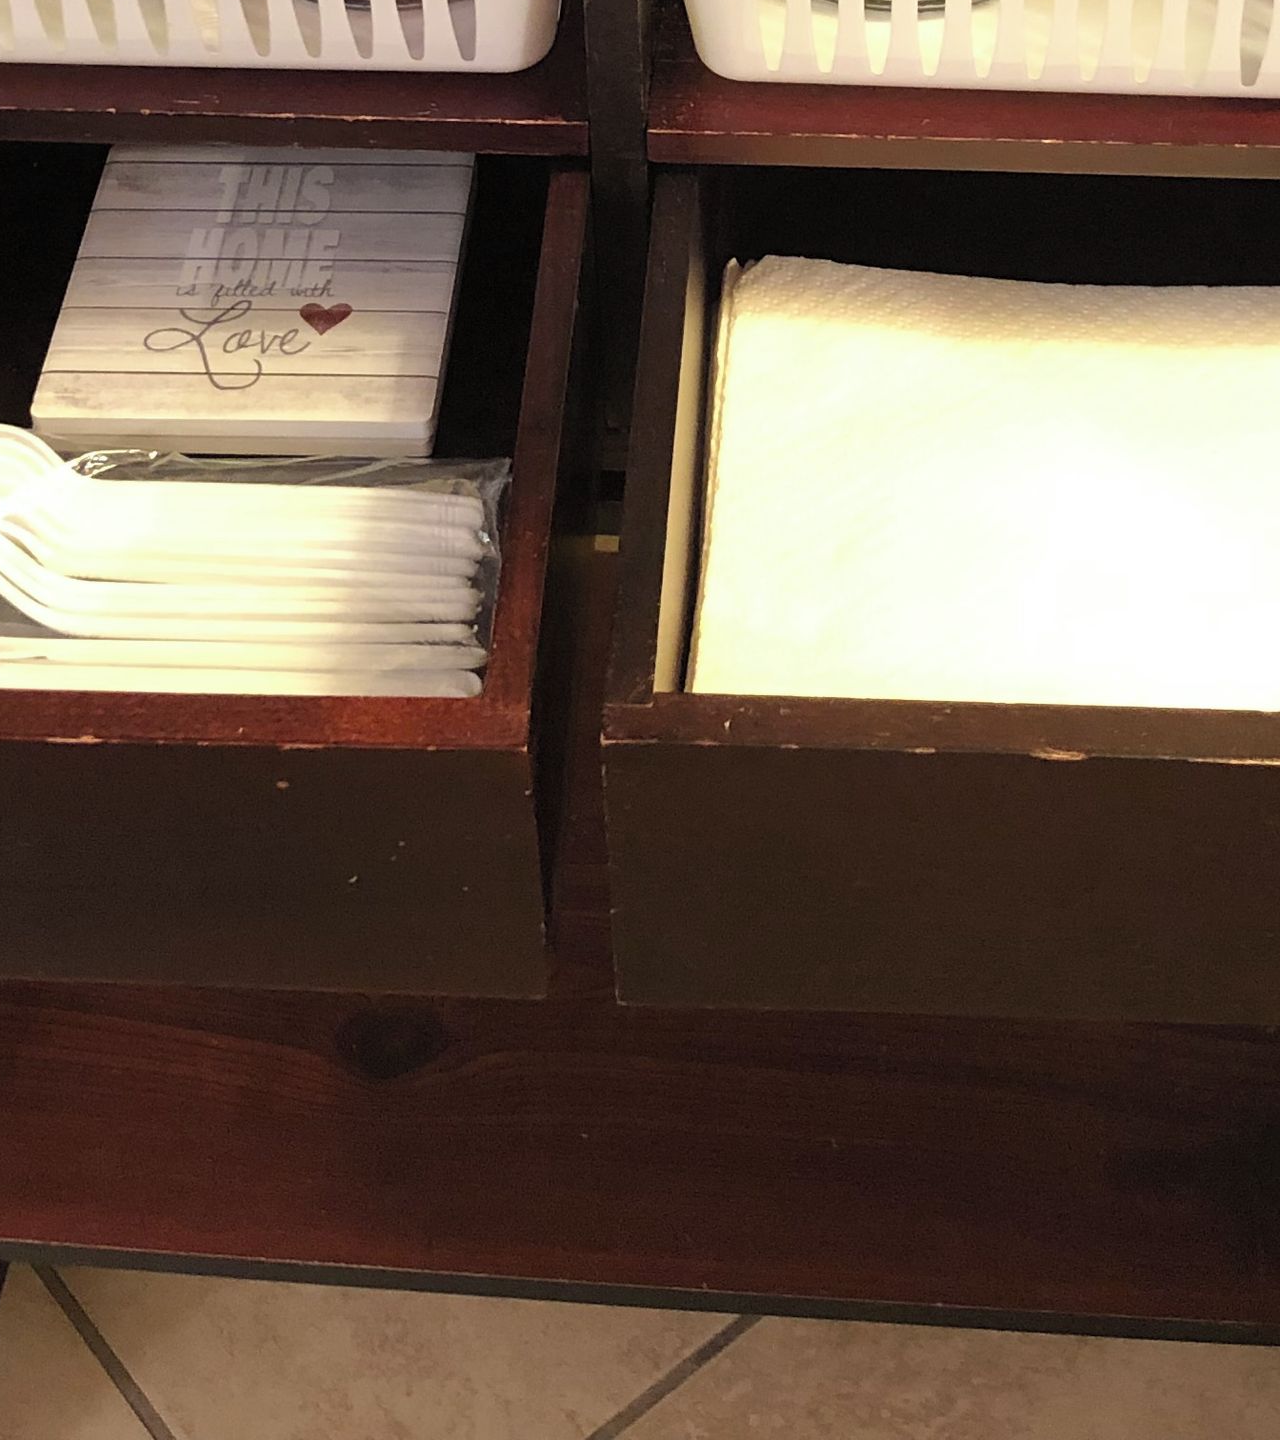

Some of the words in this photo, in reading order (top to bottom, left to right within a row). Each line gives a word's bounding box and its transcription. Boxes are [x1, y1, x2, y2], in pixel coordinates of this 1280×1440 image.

[216, 164, 336, 226] THIS
[178, 227, 342, 288] HOME
[175, 284, 199, 297] is
[289, 279, 336, 298] with
[143, 300, 313, 391] Love
